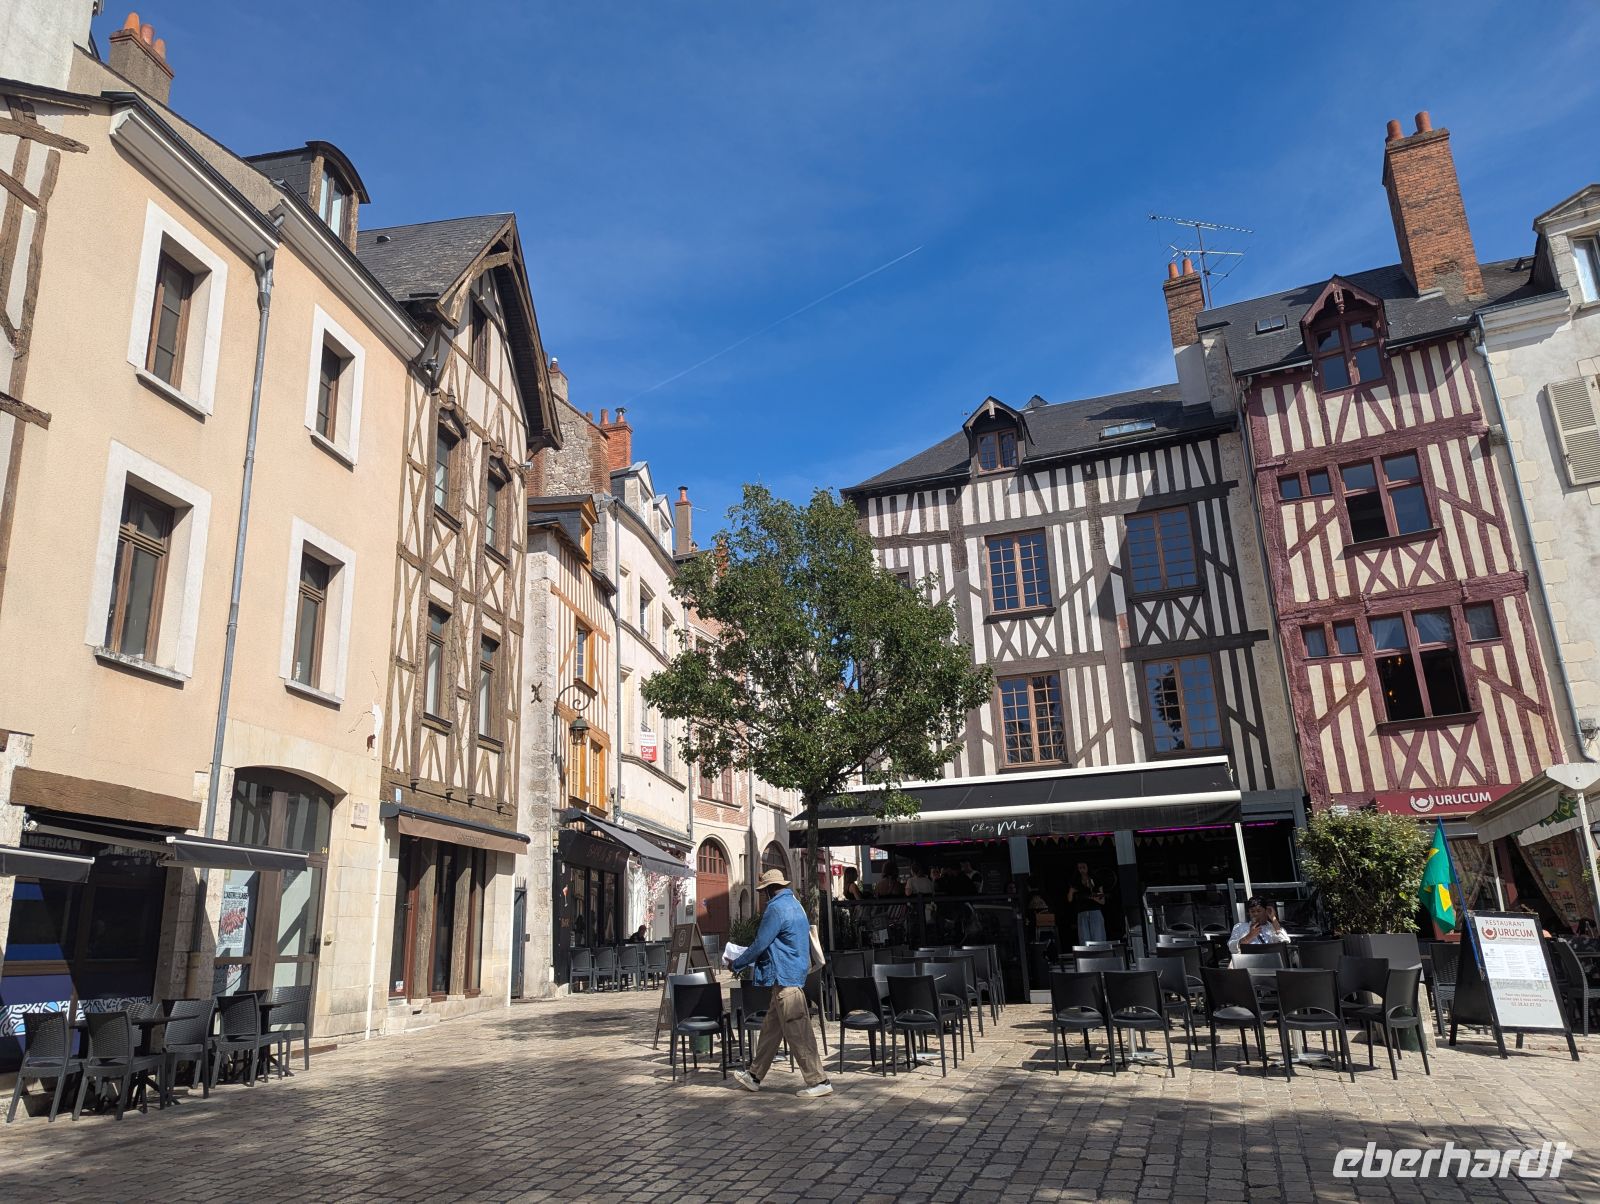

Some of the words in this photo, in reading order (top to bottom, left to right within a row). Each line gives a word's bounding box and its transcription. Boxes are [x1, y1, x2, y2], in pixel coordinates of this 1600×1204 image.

[1435, 791, 1492, 805] URUCUM
[997, 820, 1034, 836] Moi
[22, 834, 81, 850] AMERICAN
[1484, 919, 1525, 928] RESTAURANT
[1497, 927, 1535, 938] URUCUM
